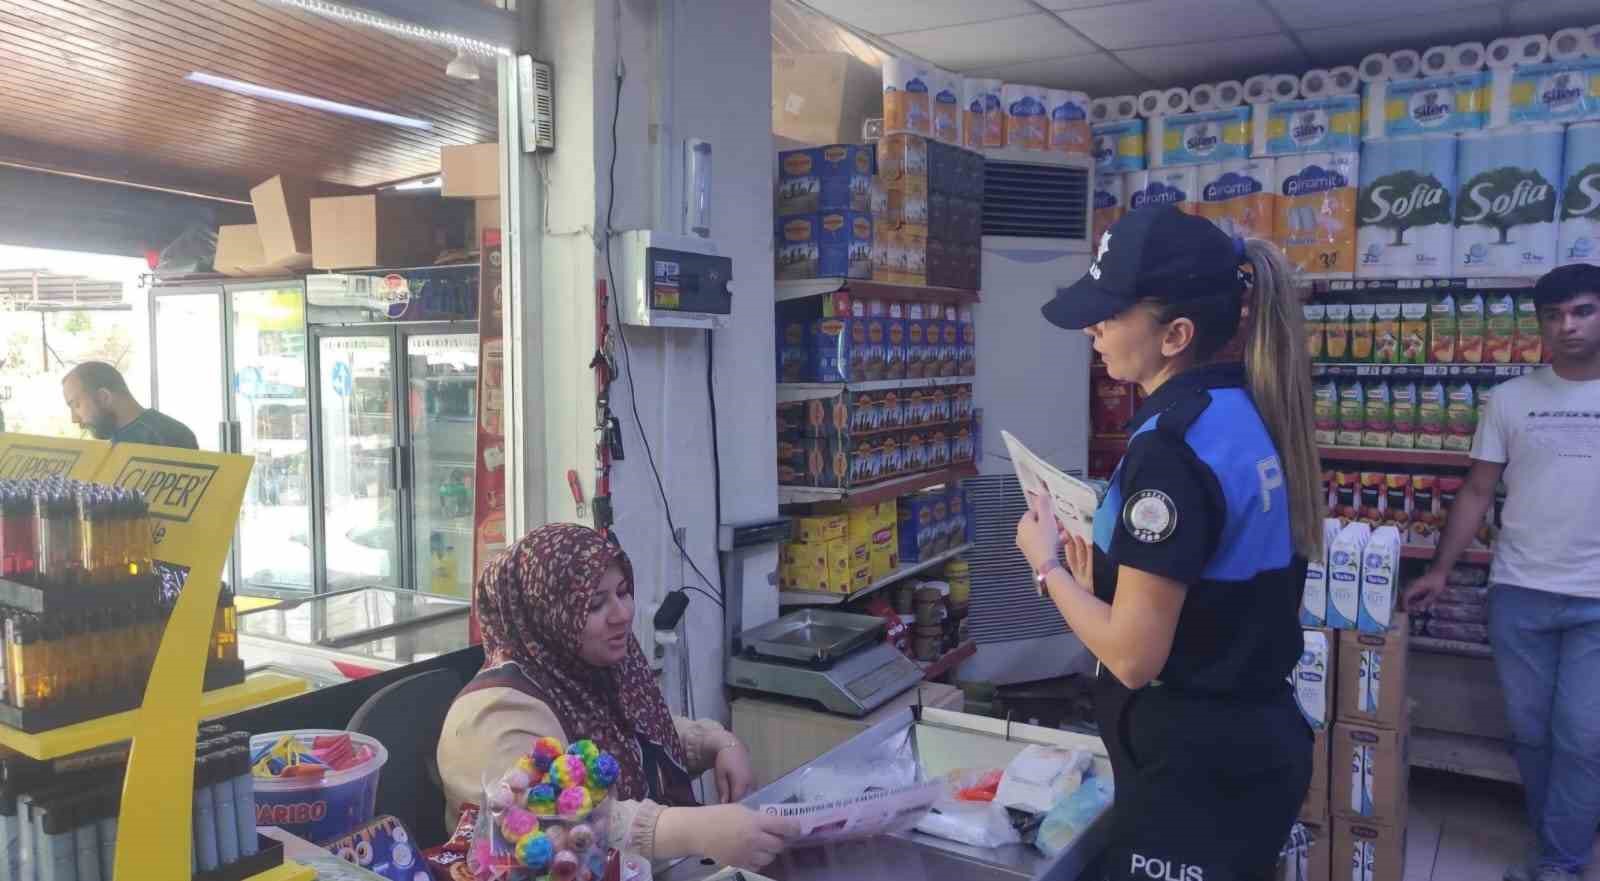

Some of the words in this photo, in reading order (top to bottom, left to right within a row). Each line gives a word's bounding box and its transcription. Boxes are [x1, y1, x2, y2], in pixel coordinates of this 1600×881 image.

[1362, 183, 1443, 223] Sofia
[1461, 179, 1548, 222] Sofia
[121, 467, 203, 508] CLIPPER
